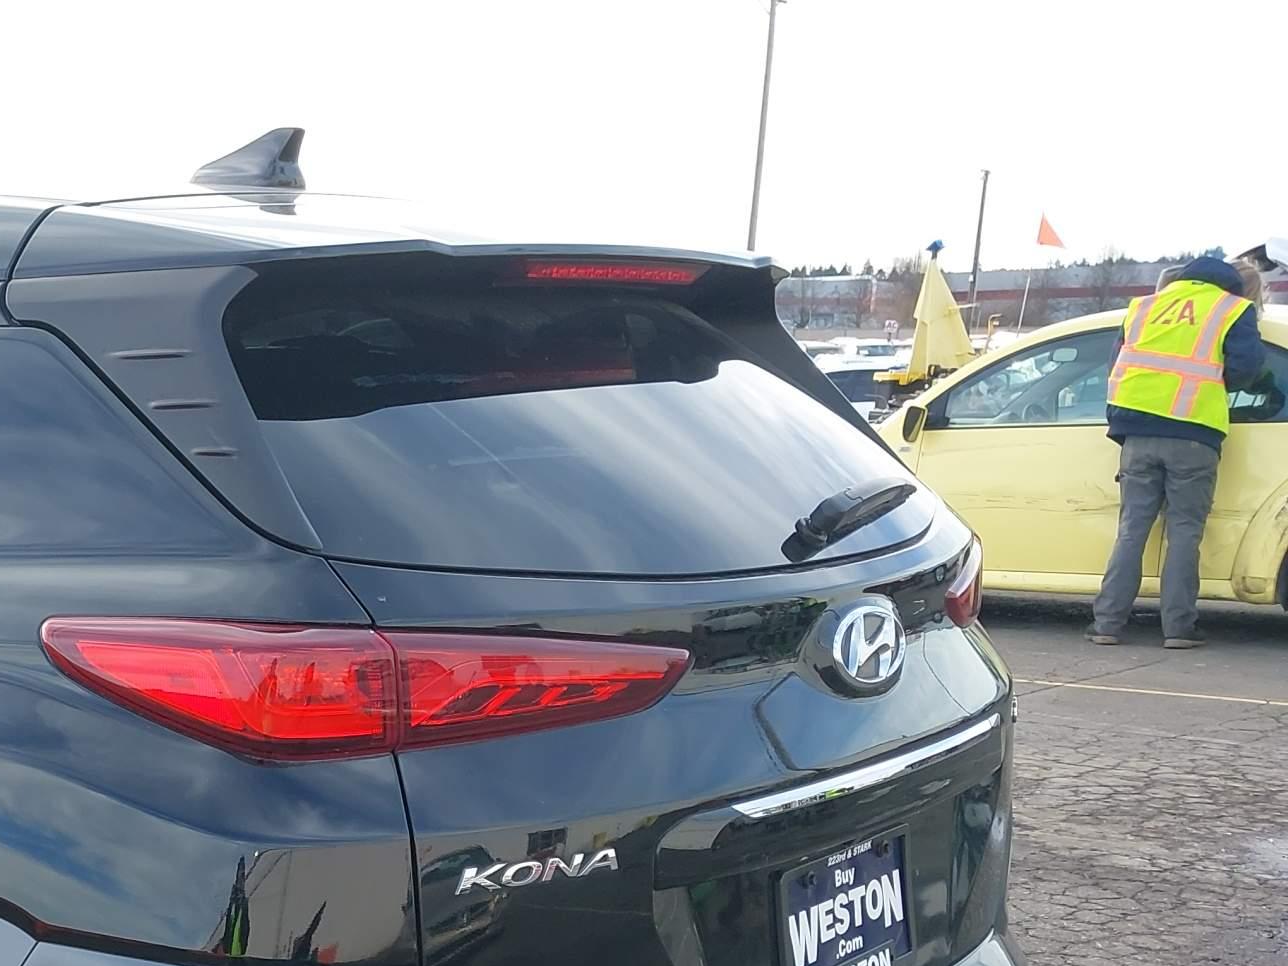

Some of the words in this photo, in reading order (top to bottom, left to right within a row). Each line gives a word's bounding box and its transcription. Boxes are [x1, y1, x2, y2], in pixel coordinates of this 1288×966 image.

[853, 840, 872, 857] STARK
[455, 849, 619, 895] KONA
[835, 867, 856, 887] Buy
[836, 936, 863, 959] .Com
